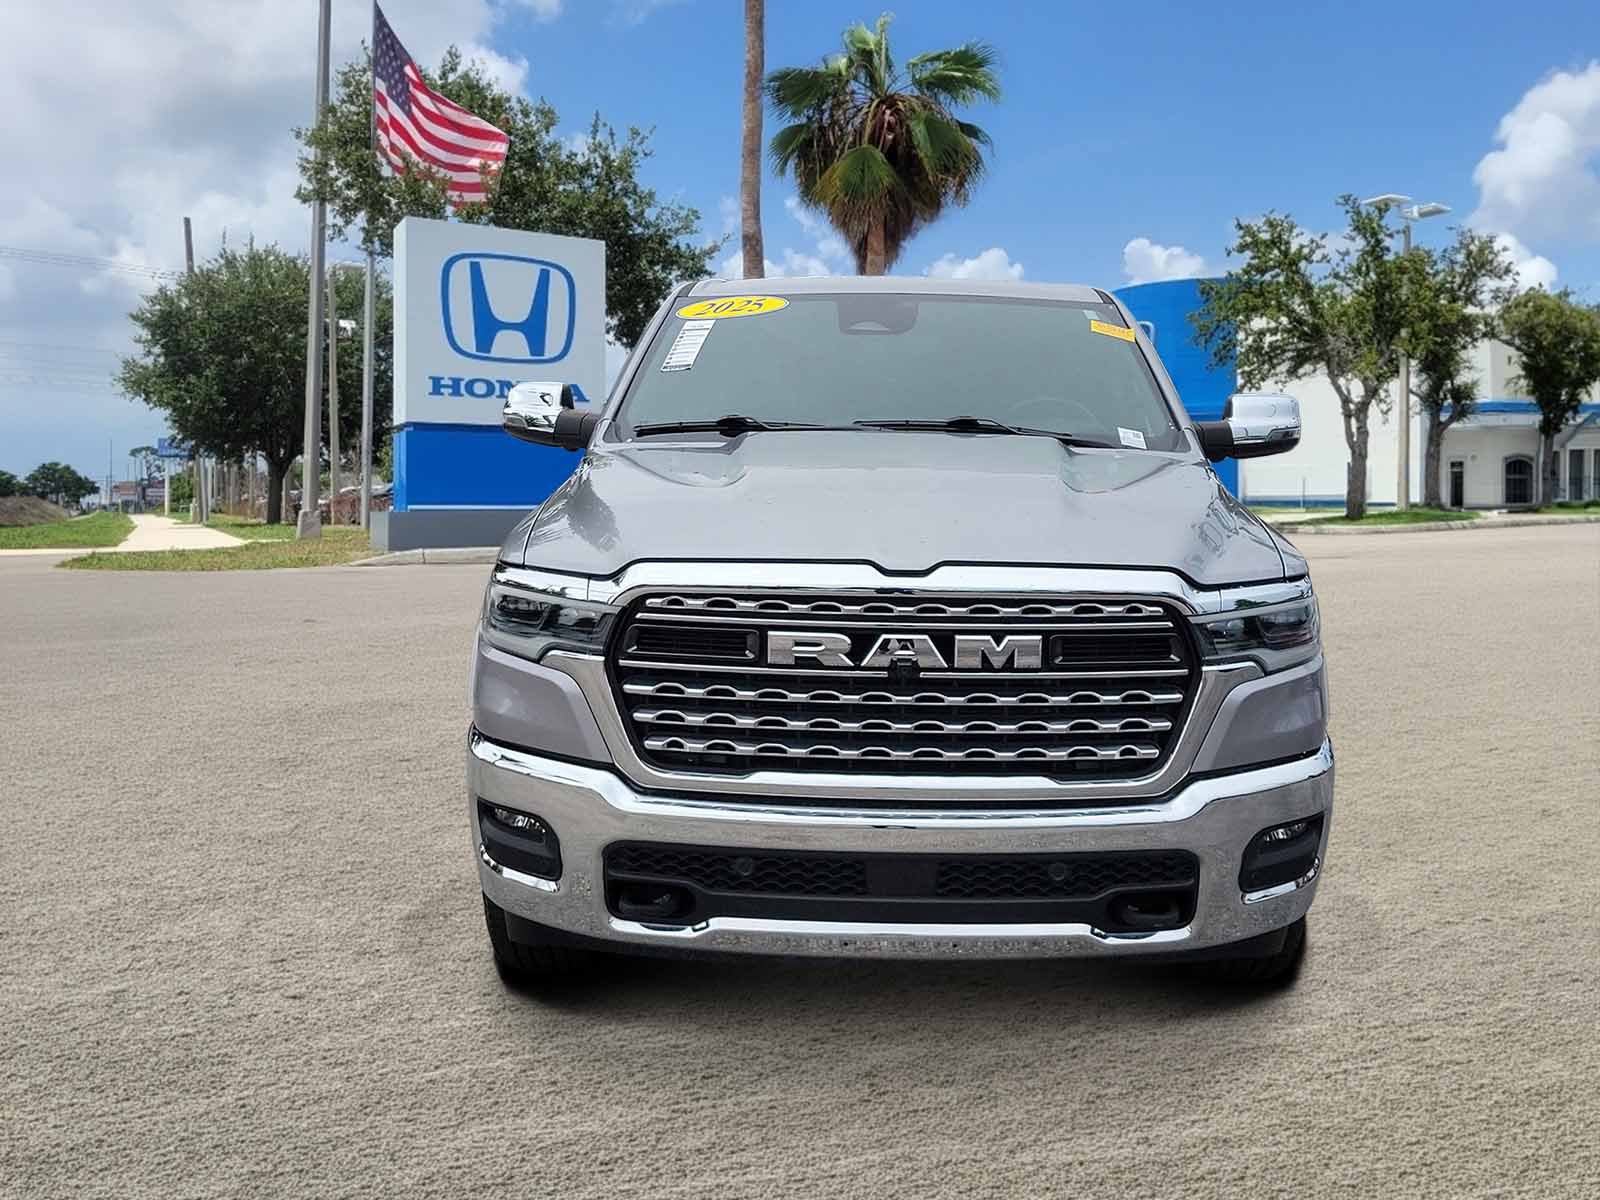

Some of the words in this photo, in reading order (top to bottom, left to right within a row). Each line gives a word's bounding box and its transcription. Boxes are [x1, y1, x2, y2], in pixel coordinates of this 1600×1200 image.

[694, 298, 767, 316] 2025
[428, 376, 590, 403] HONA
[767, 630, 1043, 669] RAM
